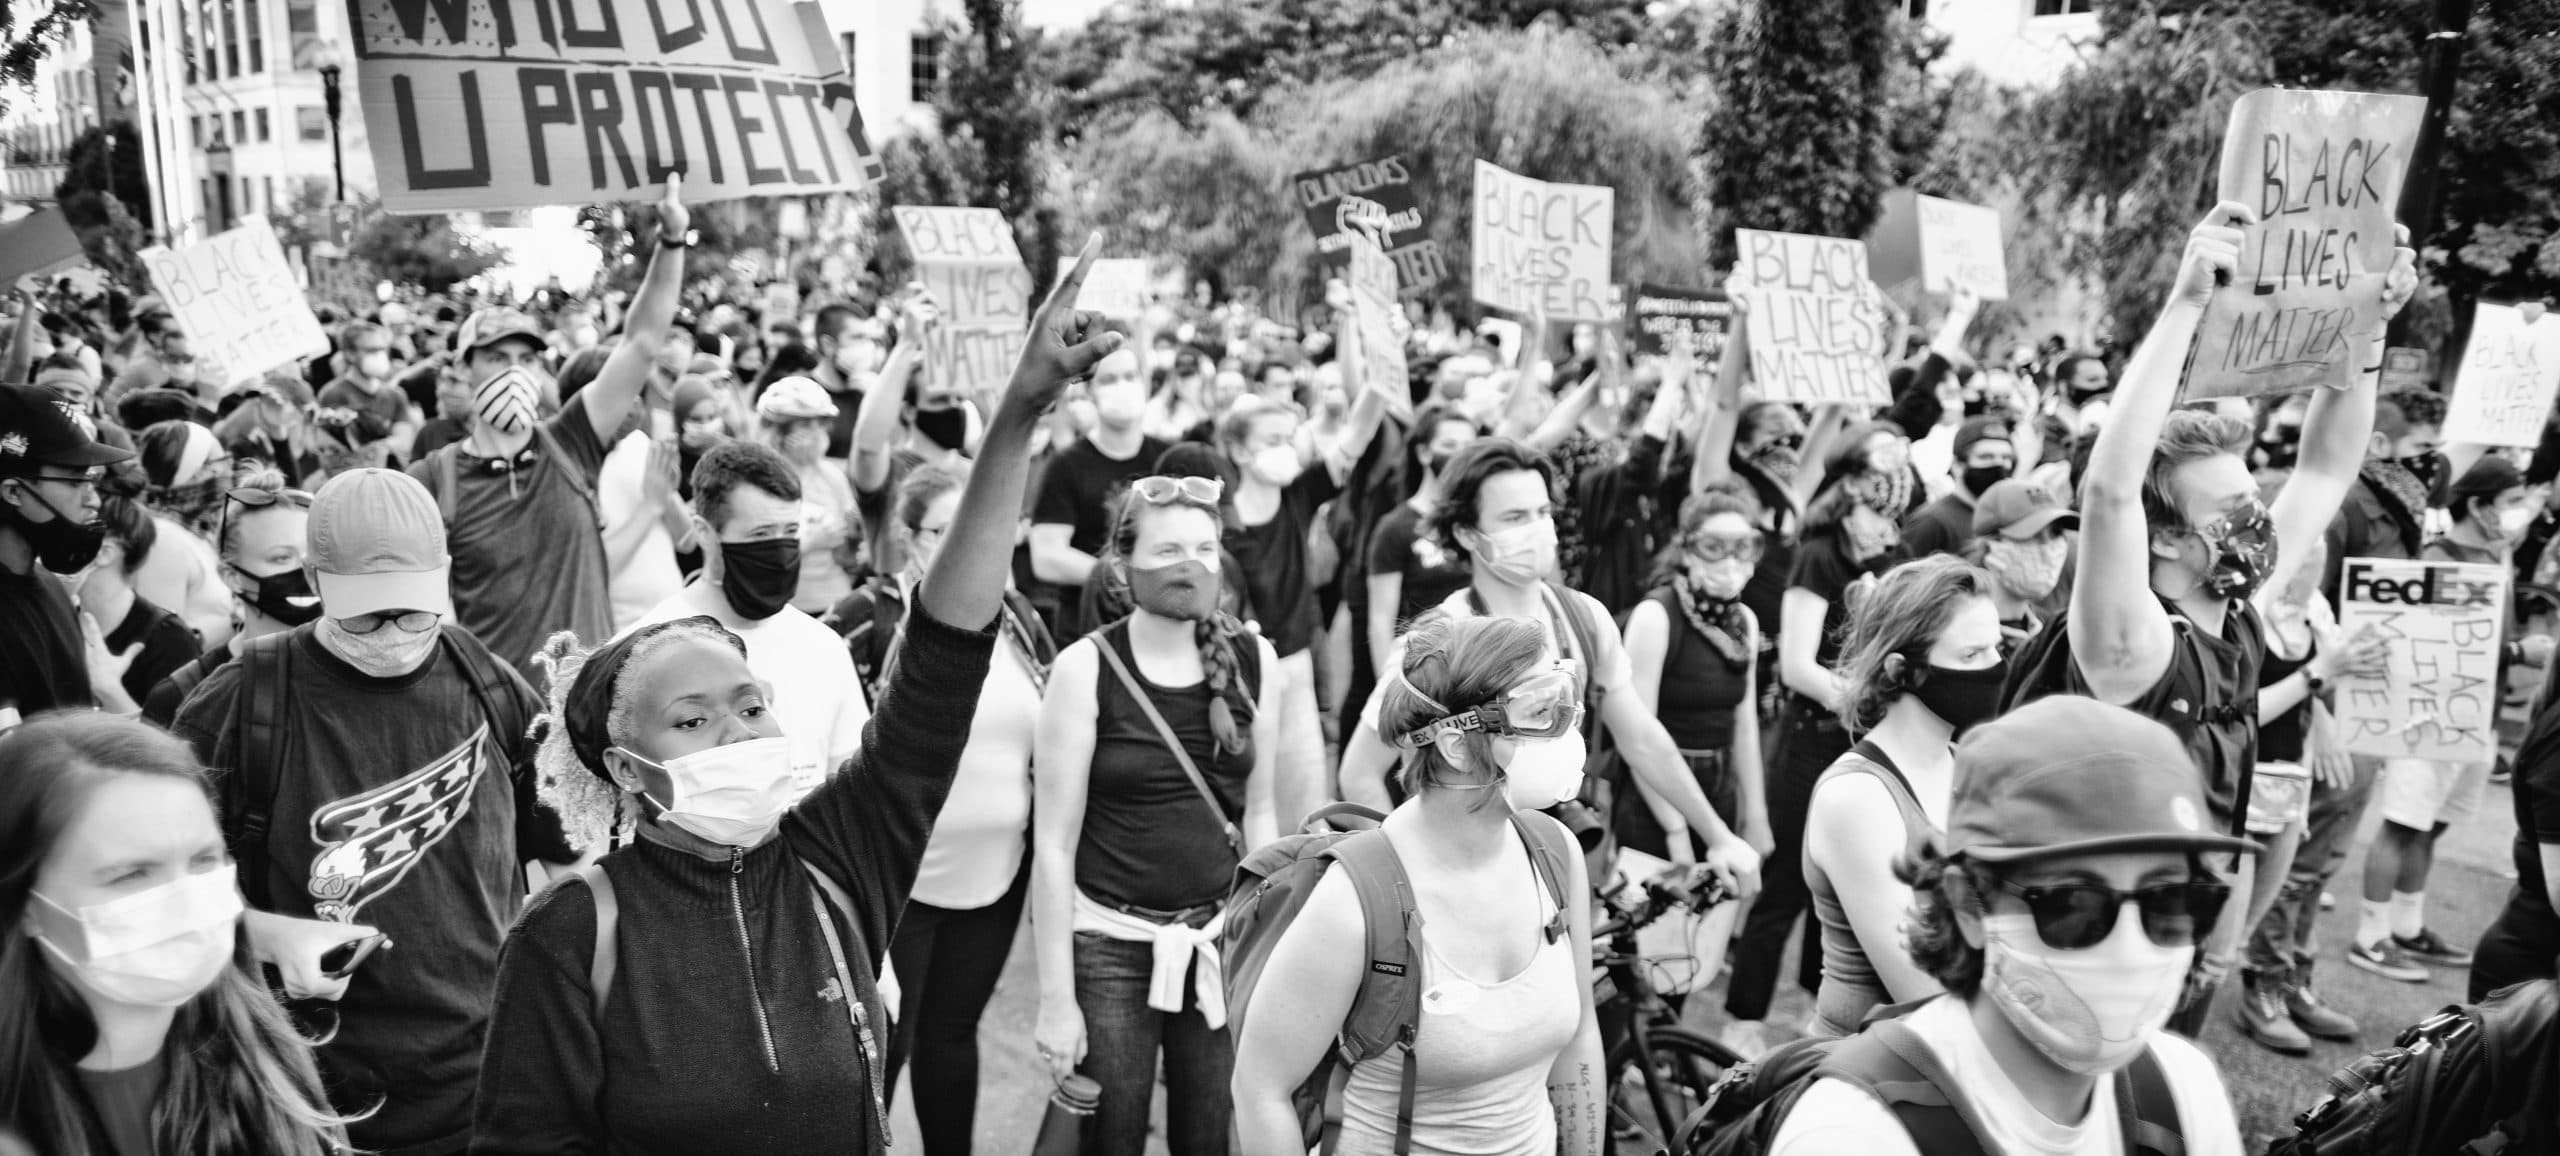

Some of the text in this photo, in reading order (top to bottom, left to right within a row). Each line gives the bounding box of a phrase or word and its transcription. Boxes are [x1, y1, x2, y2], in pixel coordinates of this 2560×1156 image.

[391, 67, 882, 190] U PROTECT?
[1483, 170, 1602, 249] BLACK
[2261, 132, 2391, 222] BLACK
[902, 209, 1003, 256] BLACK
[1485, 230, 1572, 281] LIVES
[1751, 231, 1868, 298] BLACK
[2253, 228, 2358, 296] LIVES
[156, 231, 273, 308] BLACK
[183, 272, 293, 339] LIVES
[1767, 293, 1873, 352] LIVES
[2221, 306, 2354, 372] MATTER
[925, 329, 1022, 388] MATTE
[1756, 348, 1889, 402] MATTER
[2475, 333, 2538, 371] BLACK
[2347, 565, 2499, 607] FedEx
[2346, 610, 2407, 747] MTTER
[2402, 637, 2449, 754] LIVES
[2438, 618, 2494, 748] BLACK
